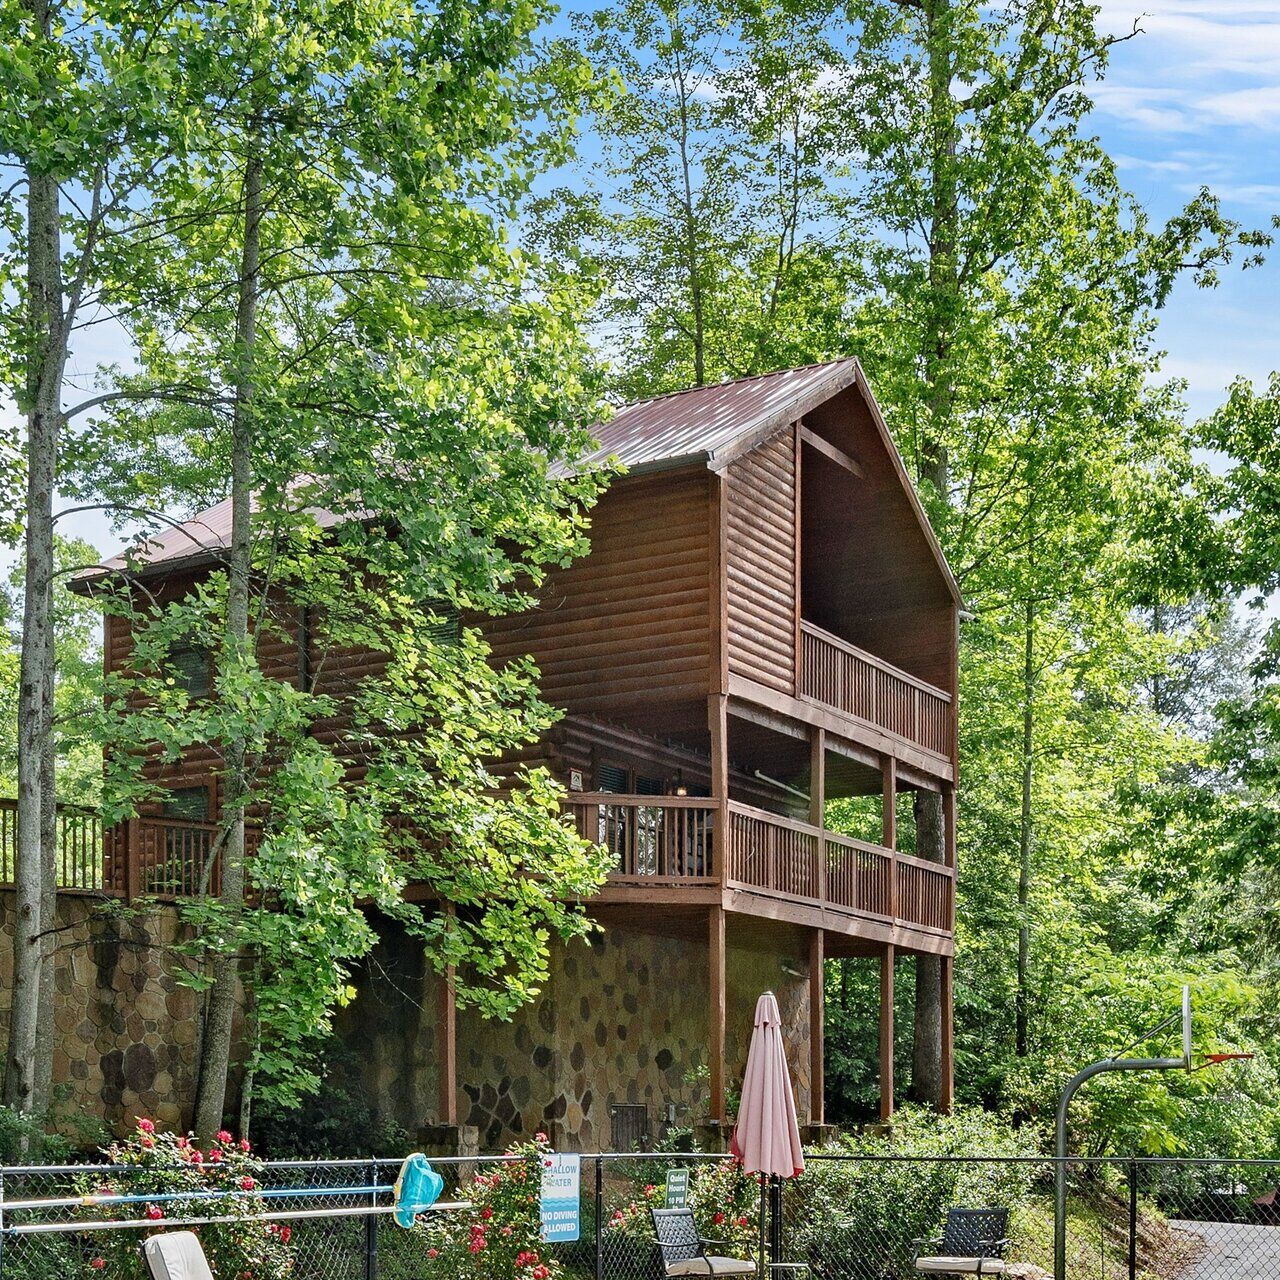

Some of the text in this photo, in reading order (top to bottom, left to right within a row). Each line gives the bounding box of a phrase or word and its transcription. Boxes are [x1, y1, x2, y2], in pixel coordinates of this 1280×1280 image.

[544, 1166, 577, 1174] HALLOW
[670, 1174, 685, 1182] Quiet
[542, 1211, 577, 1220] NO DIVING
[544, 1223, 575, 1232] ALLOWED
